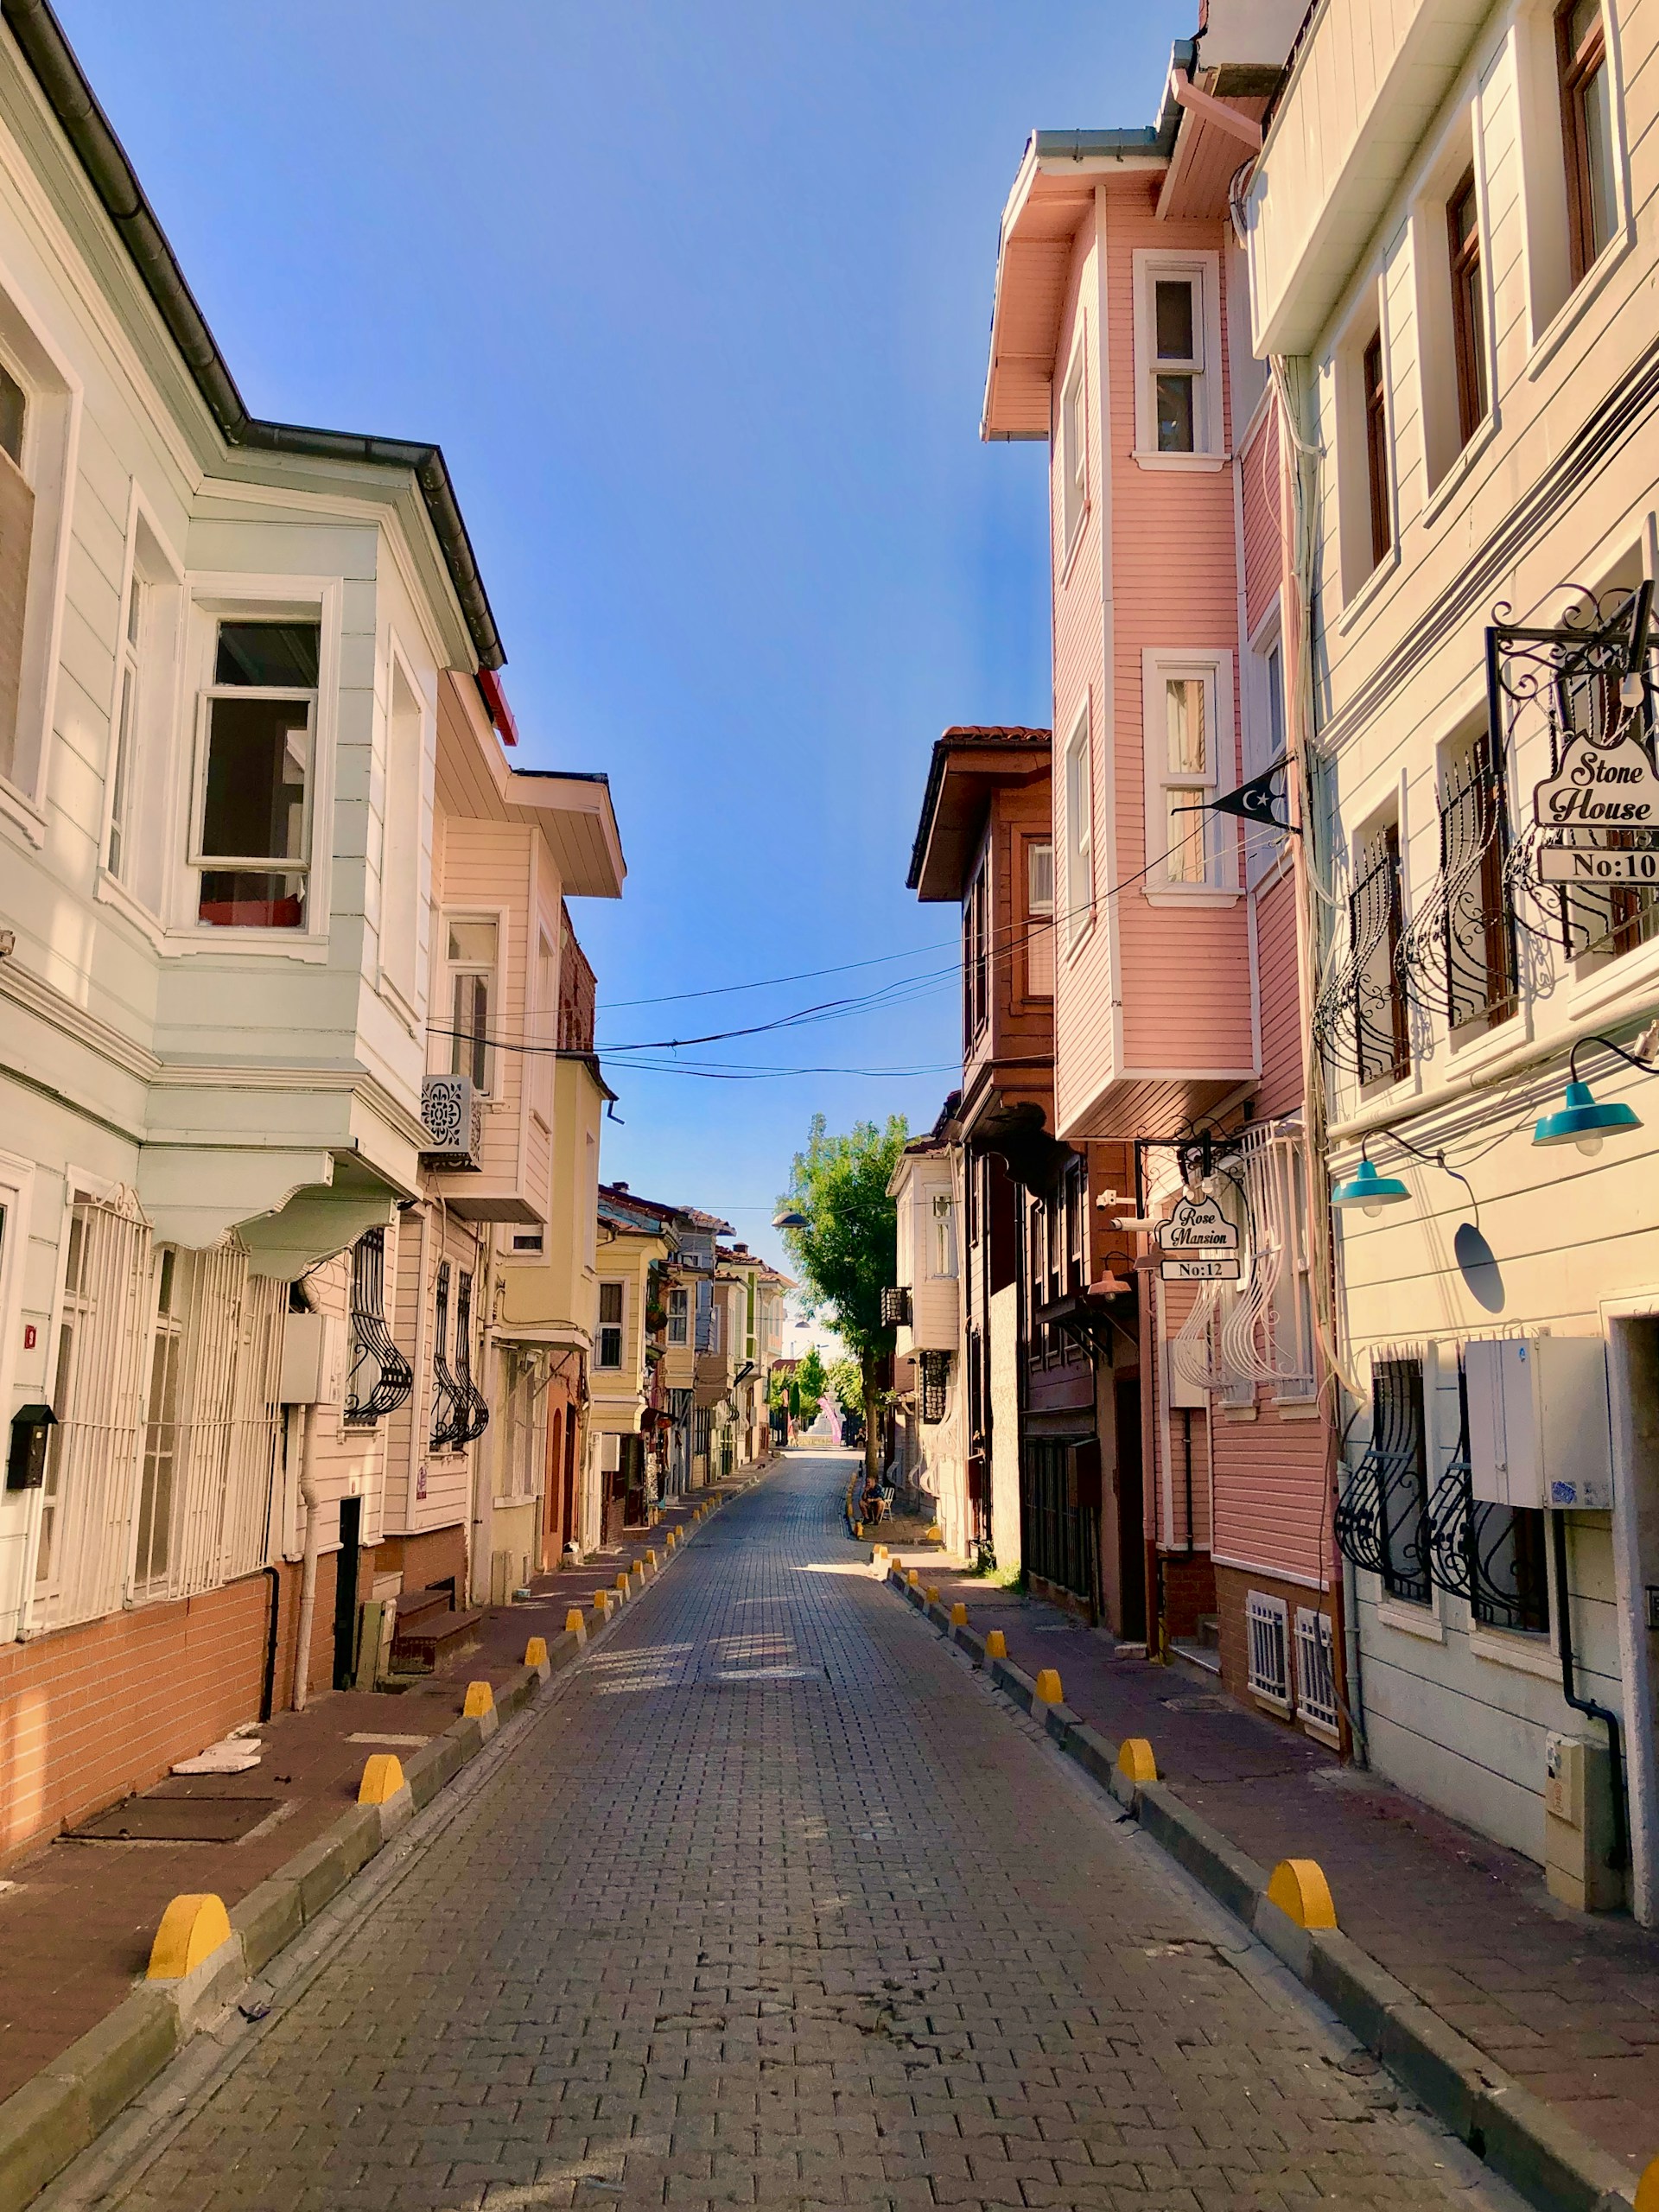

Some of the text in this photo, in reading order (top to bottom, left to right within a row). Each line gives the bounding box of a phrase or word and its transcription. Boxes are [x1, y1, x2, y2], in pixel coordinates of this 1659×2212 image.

[1571, 752, 1644, 785] Stone
[1549, 787, 1652, 821] House
[1572, 854, 1656, 877] No:10
[1179, 1207, 1216, 1226] Rose
[1171, 1227, 1227, 1246] Mansion
[1179, 1263, 1223, 1276] No:12
